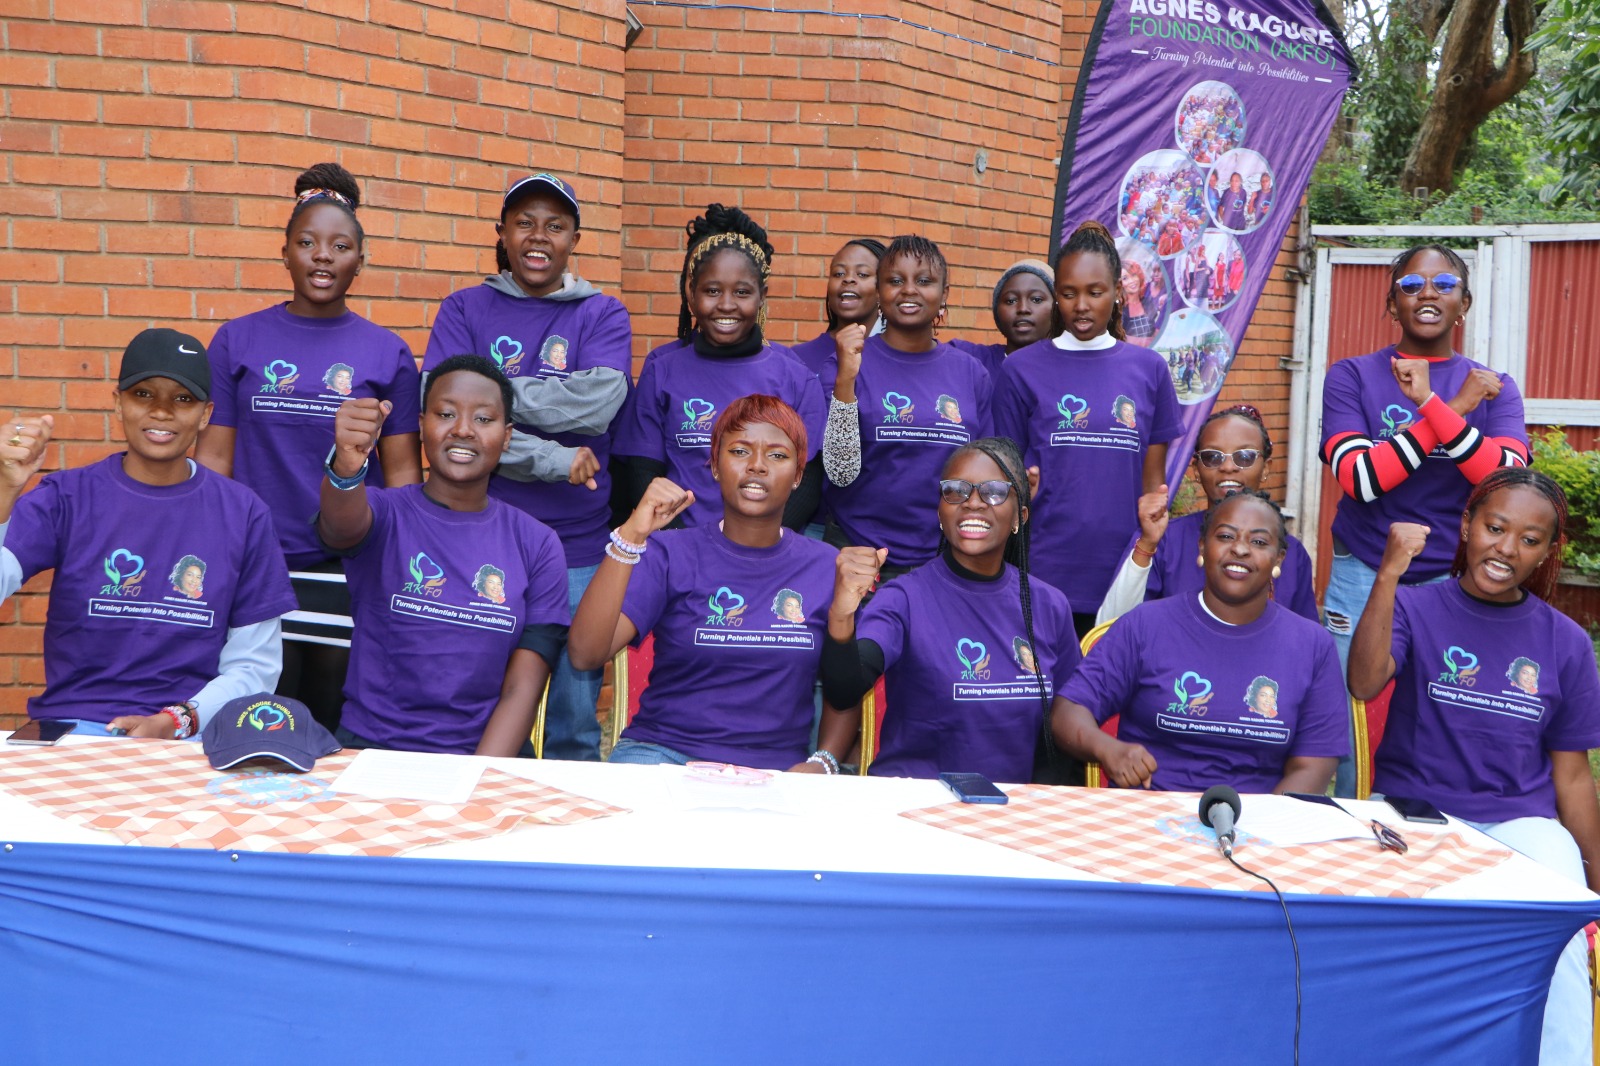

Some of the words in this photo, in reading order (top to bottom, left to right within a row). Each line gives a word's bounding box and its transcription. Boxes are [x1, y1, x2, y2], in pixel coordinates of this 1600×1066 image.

[1130, 0, 1221, 24] AGNES
[1228, 7, 1335, 50] KAGURE
[1130, 16, 1260, 53] FOUNDATION
[1270, 37, 1336, 70] (AKFO)
[1151, 46, 1190, 67] Turning
[1192, 50, 1238, 70] Potential
[1238, 61, 1254, 73] into
[1257, 62, 1310, 83] Possibilities
[255, 400, 278, 408] Turning
[278, 401, 309, 410] Potentials
[882, 414, 914, 424] AKFO
[99, 583, 142, 598] AKFO
[402, 581, 443, 598] AKFO
[94, 603, 122, 613] Turning
[152, 607, 167, 616] Into
[167, 609, 210, 621] Possibilities
[395, 599, 421, 612] Turning
[422, 605, 457, 618] Potentials
[458, 612, 472, 620] Into
[705, 614, 743, 627] AKFO
[699, 632, 725, 642] Turning
[726, 633, 761, 643] Potentials
[762, 634, 776, 643] Into
[960, 669, 991, 681] AKFO
[1438, 671, 1476, 687] AKFO
[958, 687, 981, 696] Turning
[982, 687, 1010, 695] Potentials
[1011, 686, 1024, 694] Into
[1431, 687, 1457, 700] Turning
[1457, 693, 1490, 706] Potentials
[1491, 699, 1505, 709] Into
[1166, 702, 1208, 717] AKFO
[1160, 718, 1187, 730] Turning
[1188, 723, 1226, 734] Potentials
[1227, 727, 1243, 735] Into
